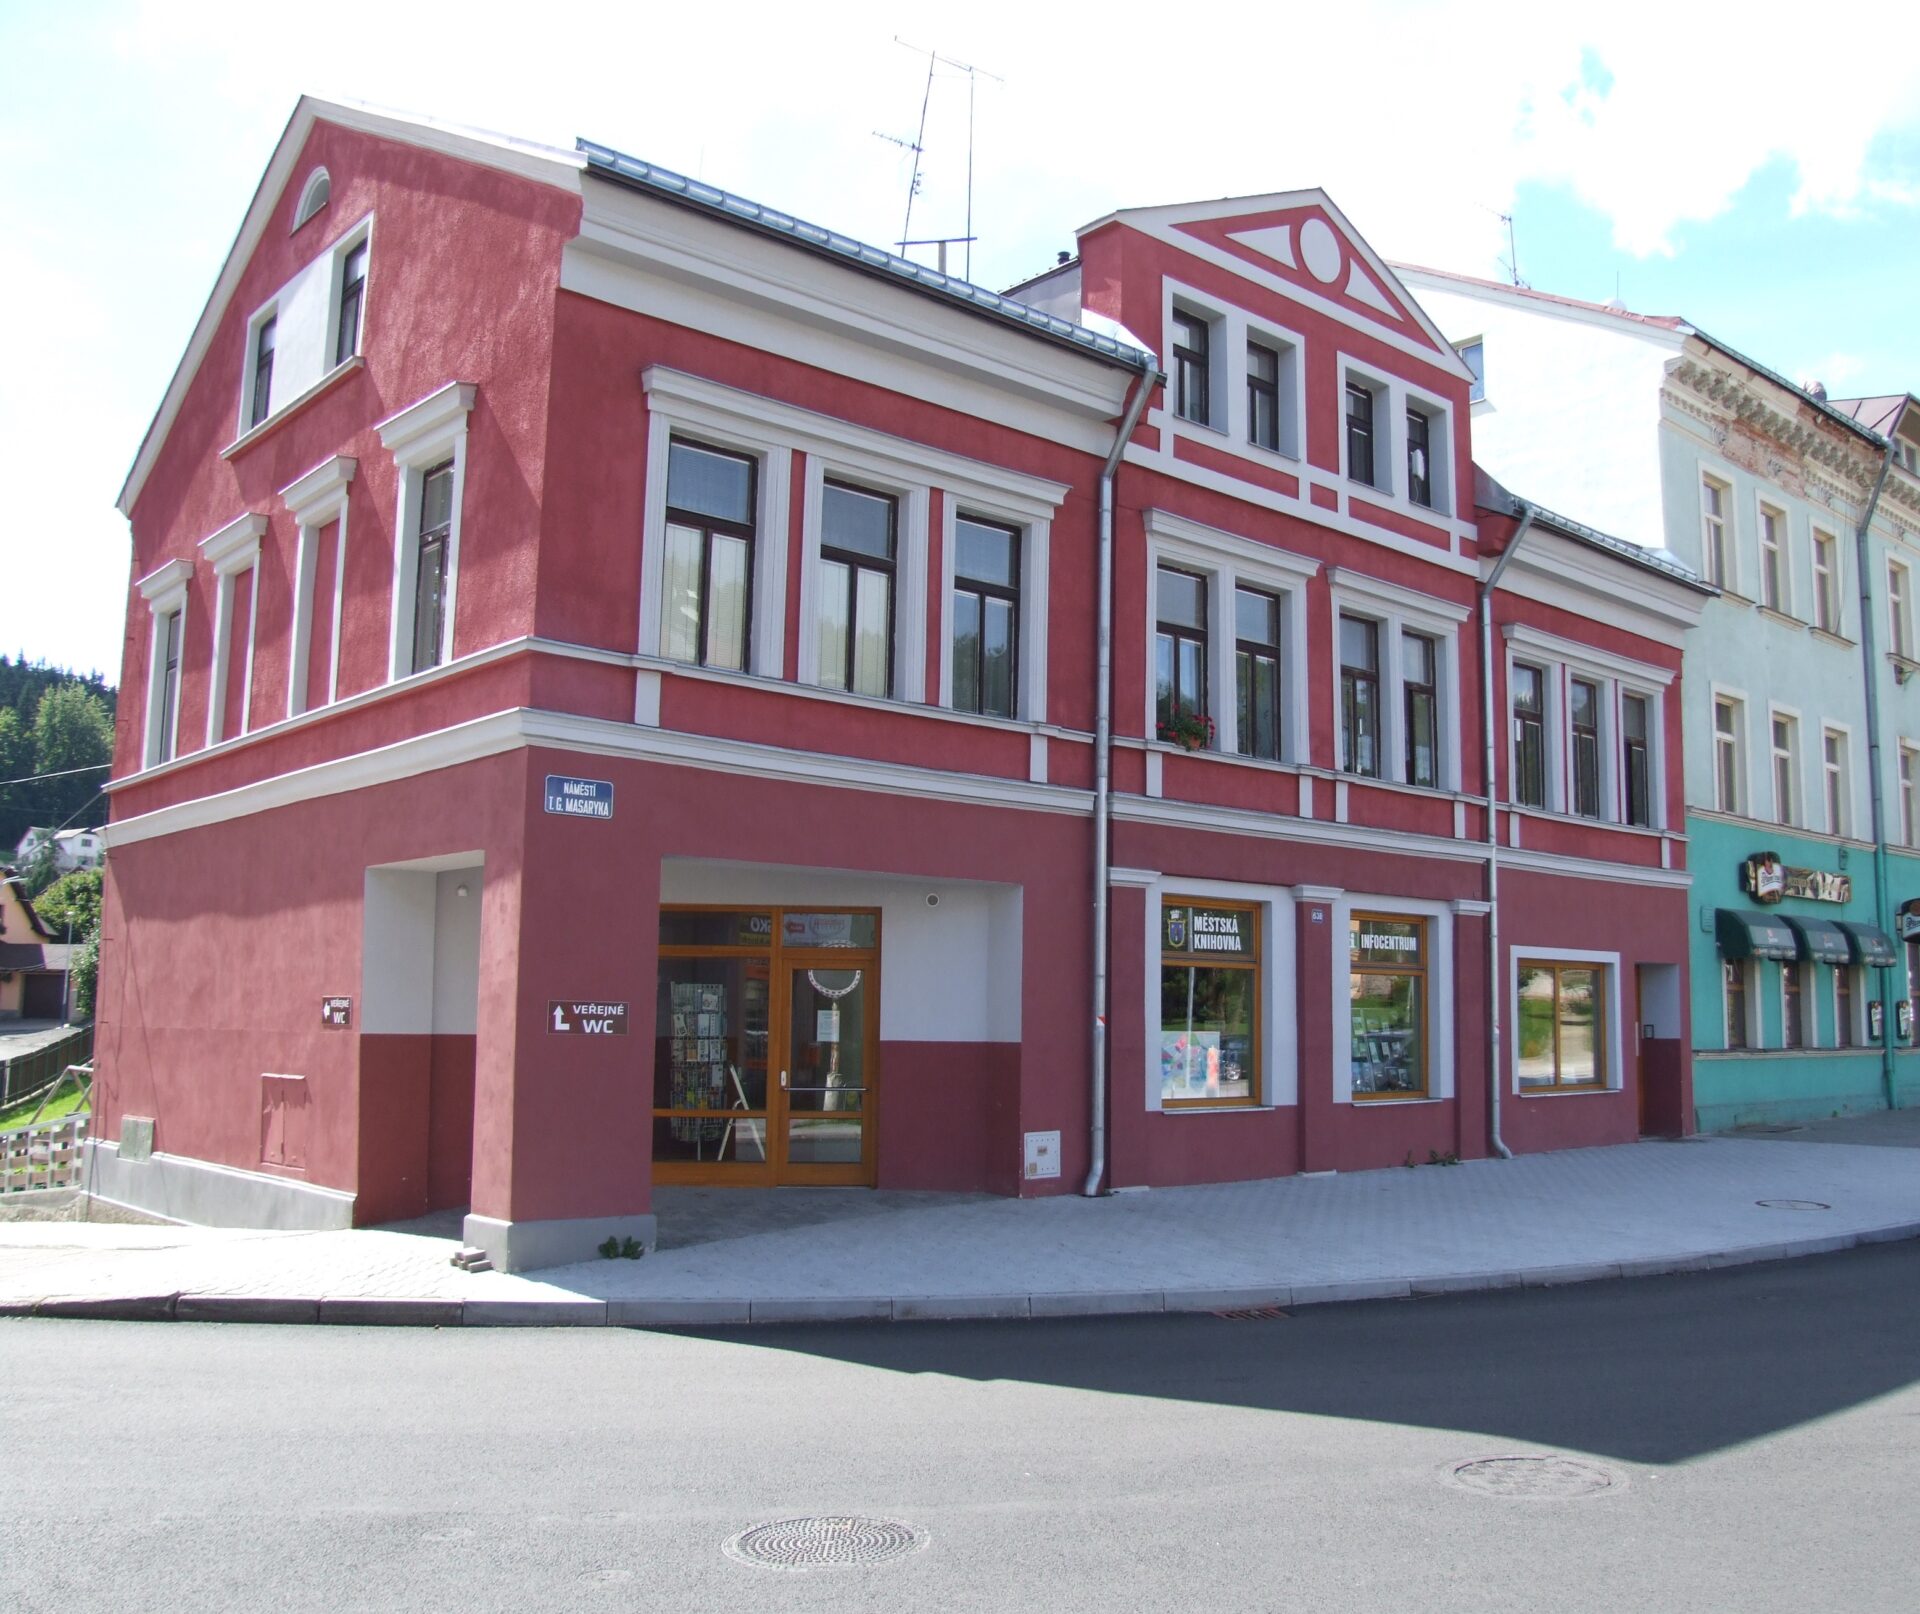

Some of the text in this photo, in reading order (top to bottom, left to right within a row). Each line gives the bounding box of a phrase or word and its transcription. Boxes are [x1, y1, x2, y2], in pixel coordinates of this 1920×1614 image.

[564, 781, 596, 797] NÁMĚSTÍ
[549, 796, 608, 816] T. G. MASARYKA
[1194, 913, 1238, 933] MĚSTSKÁ
[1194, 934, 1241, 950] KNIHOVNA
[1361, 934, 1416, 951] INFOCENTRUM
[334, 1012, 345, 1023] WC
[573, 1003, 624, 1016] VEŘEJNÉ
[583, 1020, 613, 1033] WC
